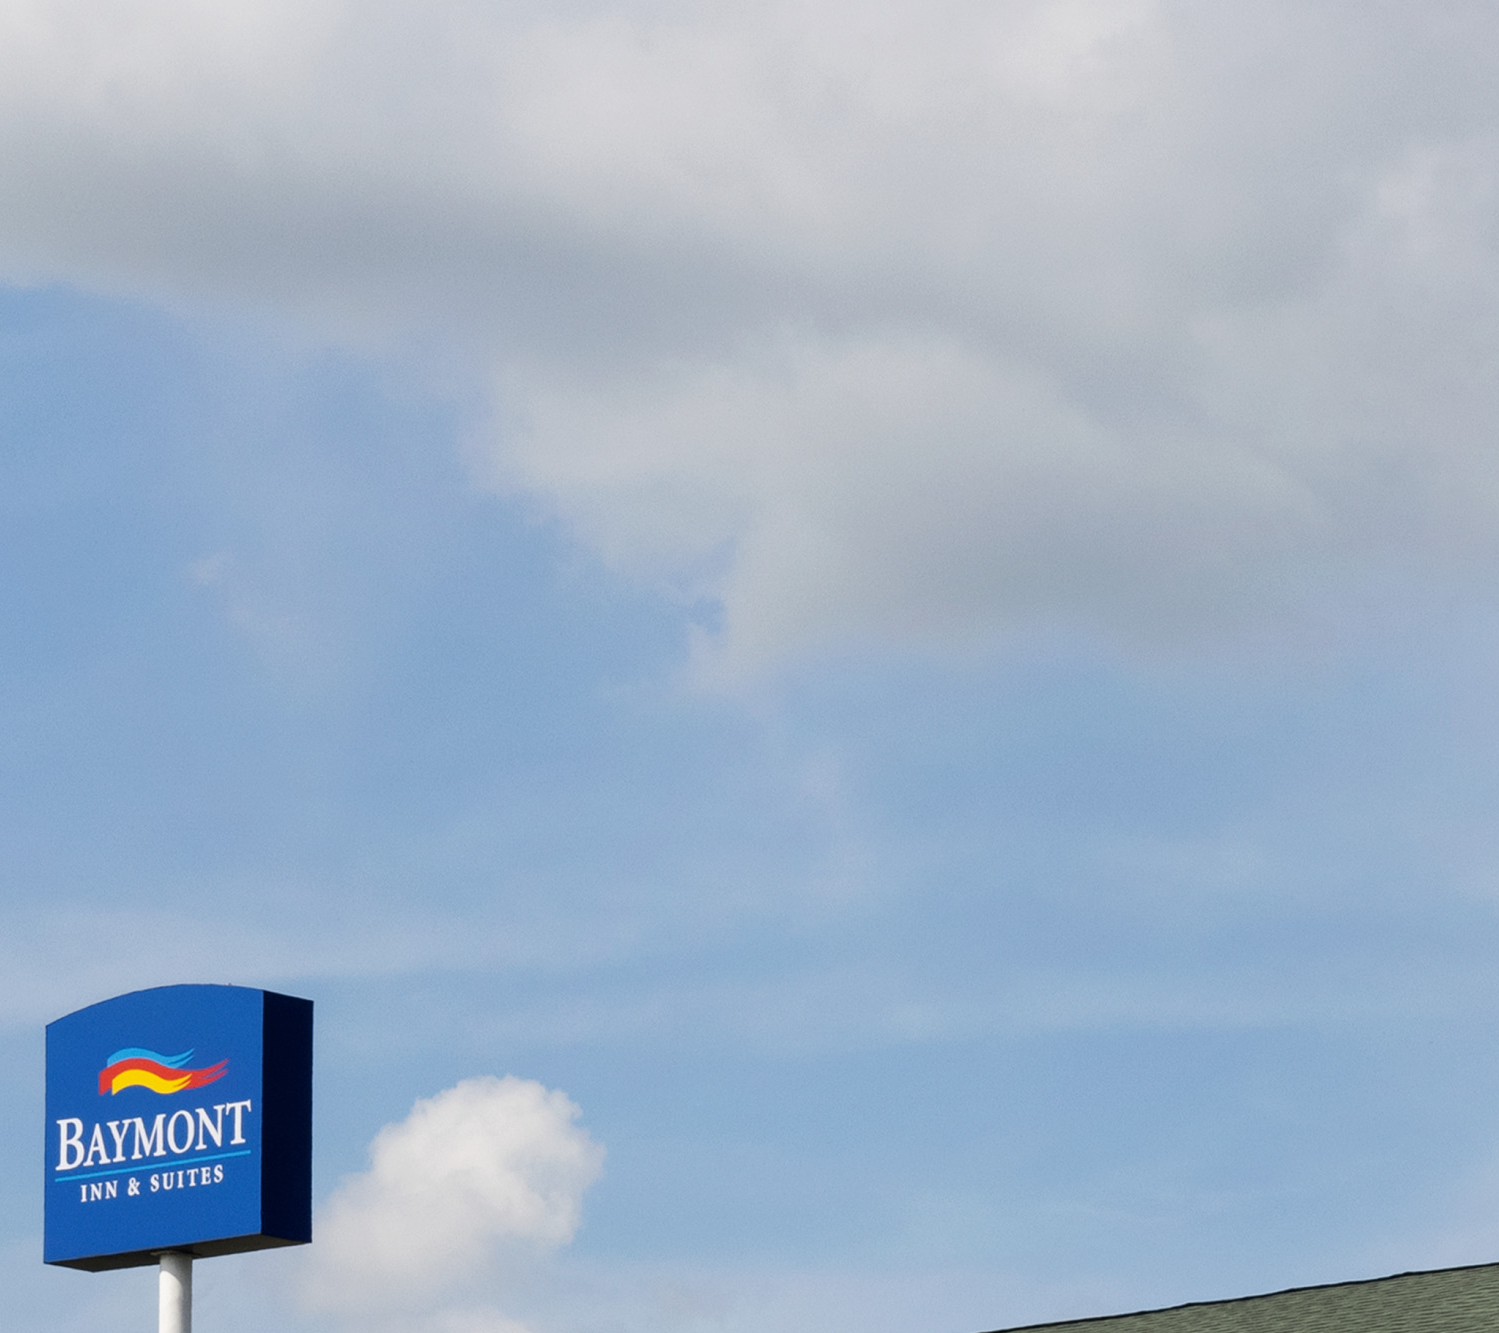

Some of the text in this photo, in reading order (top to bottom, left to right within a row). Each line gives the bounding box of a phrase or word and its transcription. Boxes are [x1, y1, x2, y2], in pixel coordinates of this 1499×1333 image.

[55, 1099, 251, 1171] BAYMONT
[81, 1164, 224, 1203] INN & SUITES
